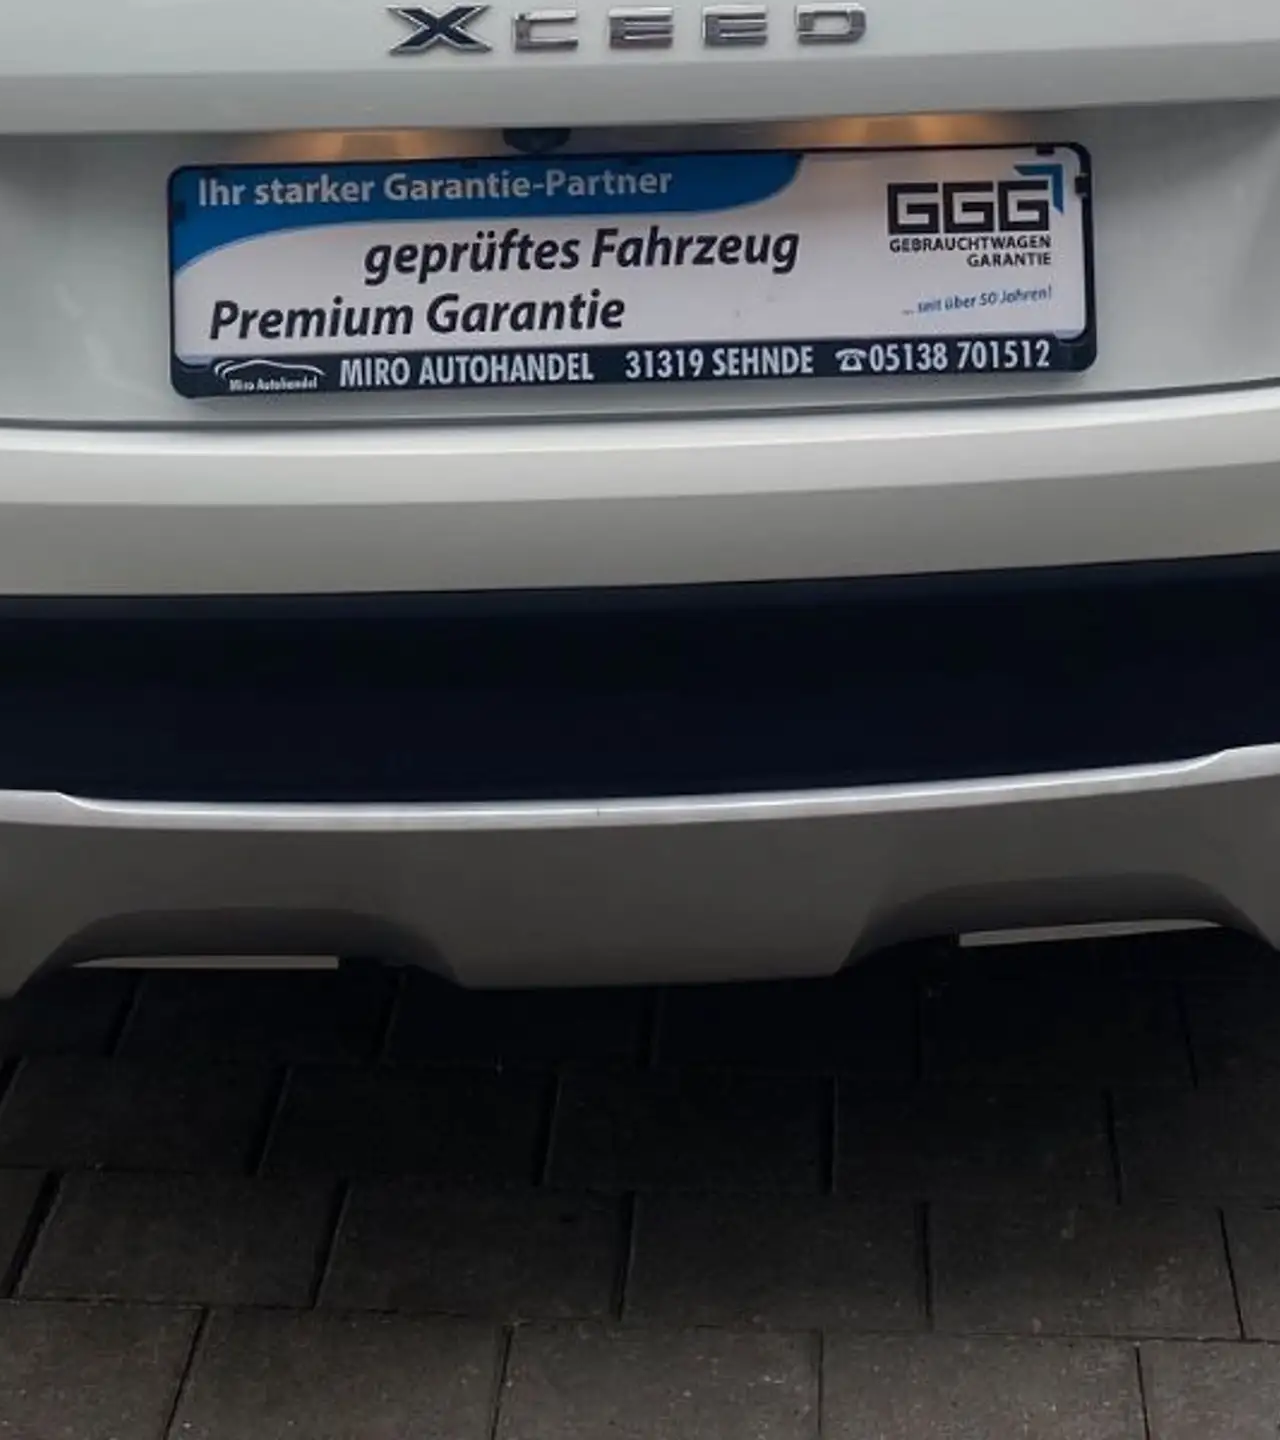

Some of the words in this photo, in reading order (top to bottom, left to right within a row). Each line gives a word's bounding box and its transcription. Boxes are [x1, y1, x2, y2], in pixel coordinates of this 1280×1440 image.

[384, 2, 868, 55] XCEED
[198, 177, 247, 207] Ihr
[254, 173, 375, 205] starker
[384, 169, 673, 201] Garantie-Partner
[887, 180, 1050, 235] GGG
[364, 227, 580, 286] geprüftes
[591, 225, 800, 275] Fahrzeug
[889, 235, 1052, 253] GEBRAUCHTWAGEN
[966, 251, 1052, 268] GARANTIE
[209, 295, 414, 340] Premium
[426, 288, 625, 334] Garantie
[945, 294, 976, 310] über
[979, 291, 997, 307] 50
[230, 378, 255, 392] Miro
[338, 357, 411, 388] MIRO
[419, 352, 595, 386] AUTOHANDEL
[625, 348, 704, 379] 31319
[712, 345, 814, 377] SEHNDE
[870, 341, 949, 372] 05138
[957, 339, 1051, 370] 701512
